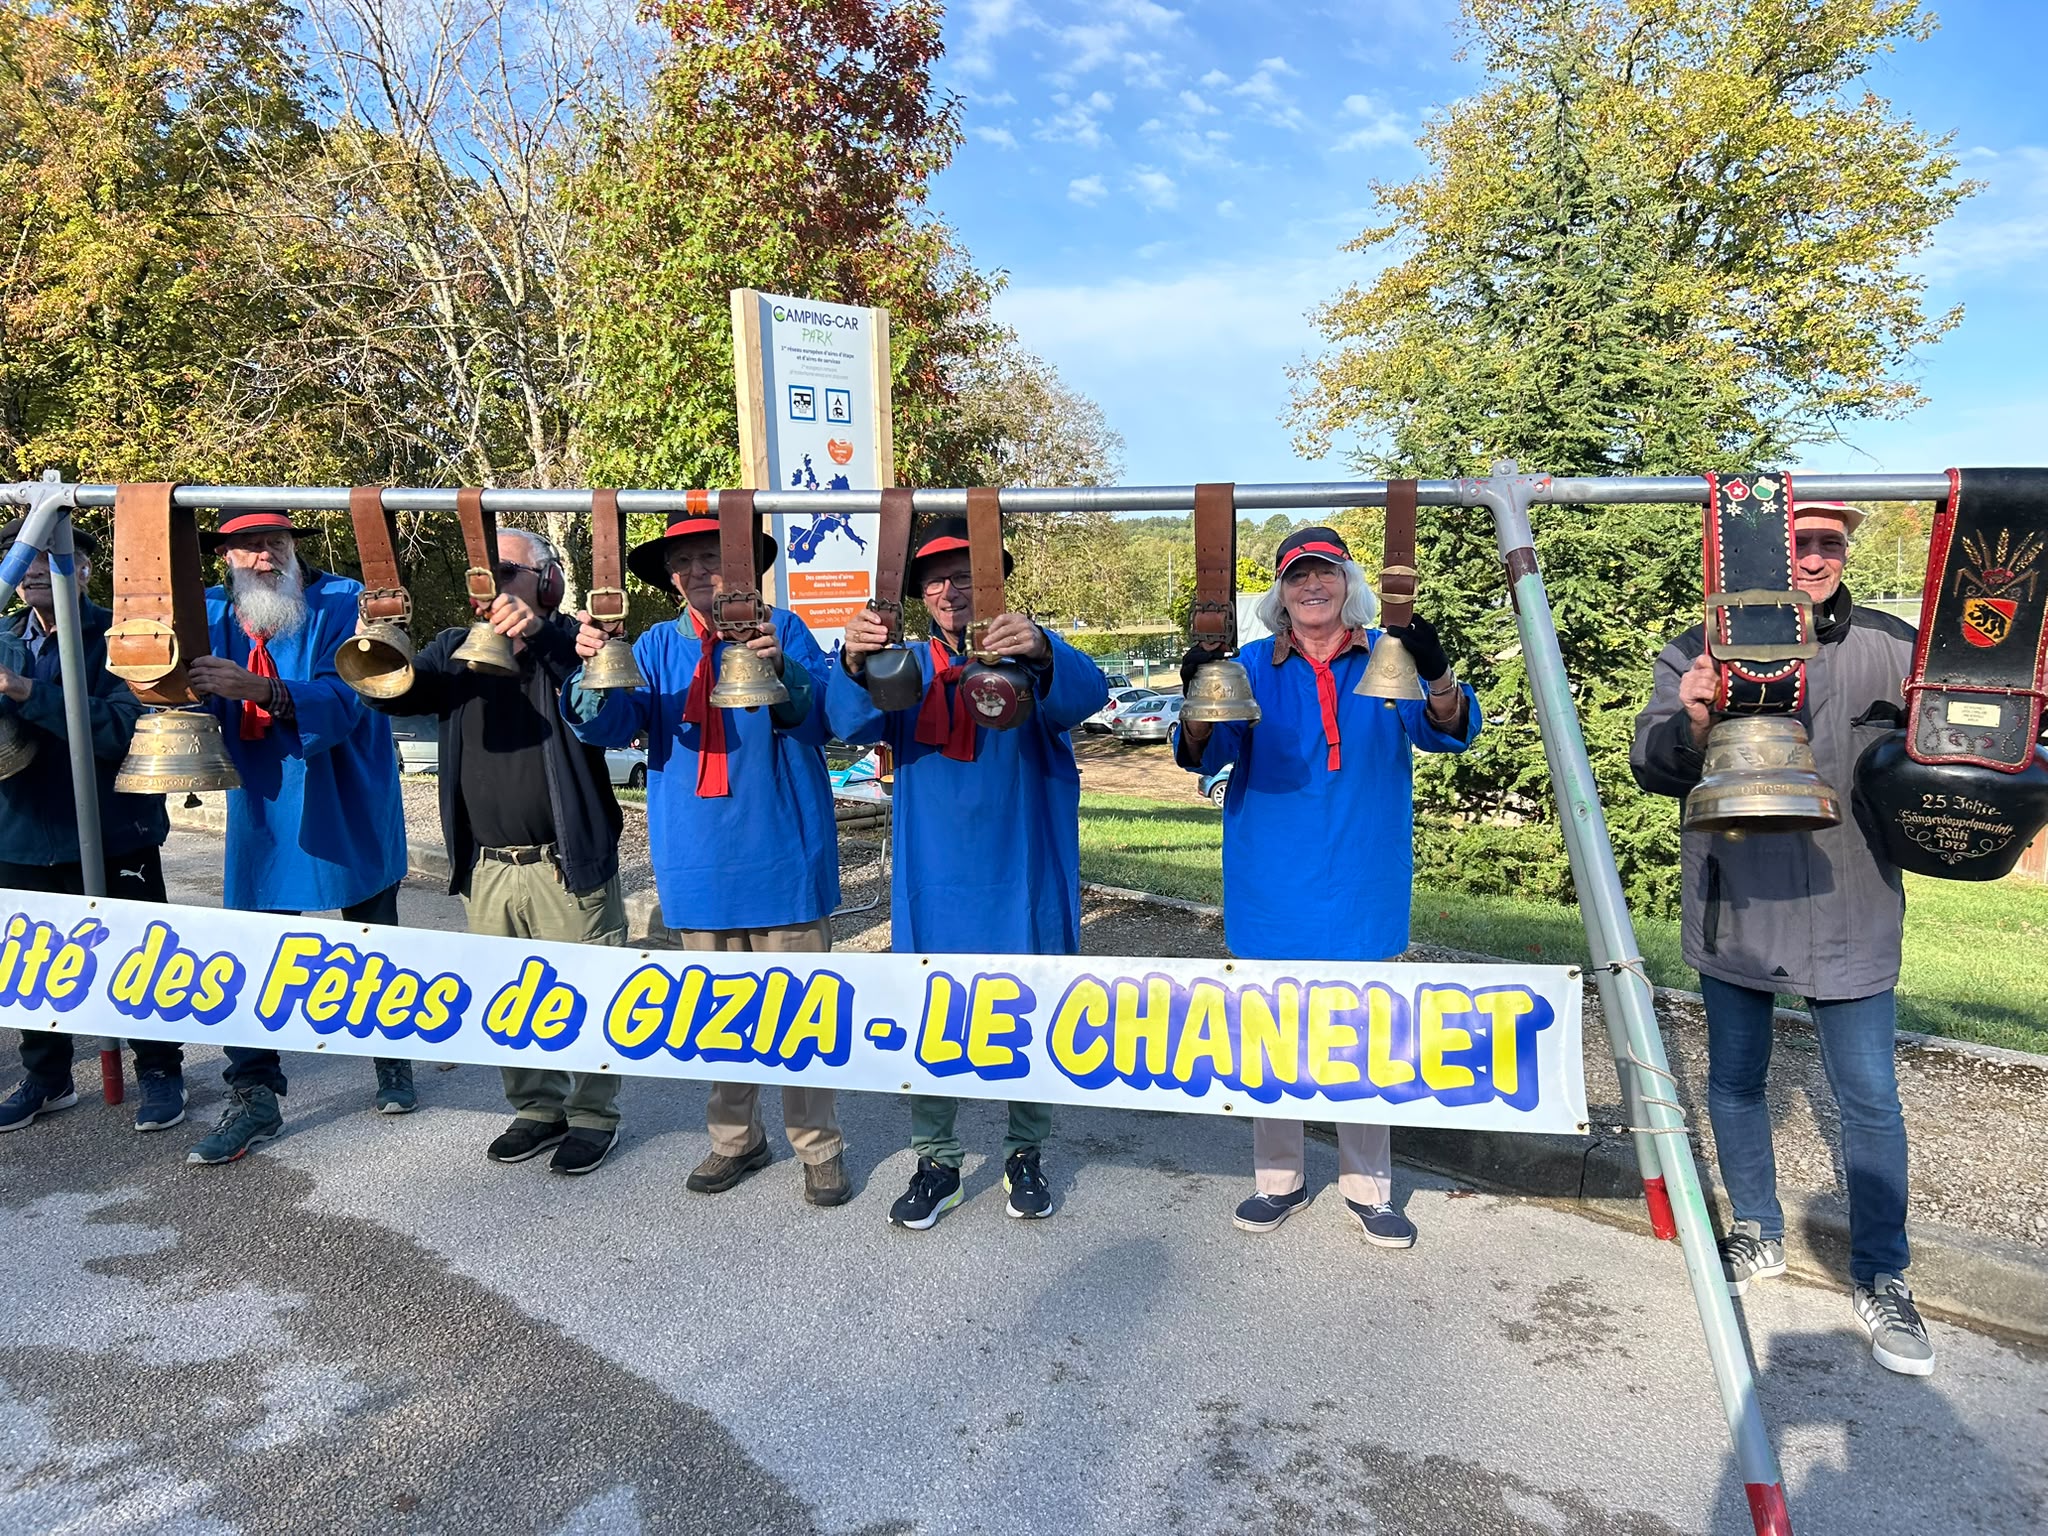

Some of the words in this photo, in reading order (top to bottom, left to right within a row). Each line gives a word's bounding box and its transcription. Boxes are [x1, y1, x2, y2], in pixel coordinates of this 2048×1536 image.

[773, 305, 859, 331] CAMPING-CAR
[802, 328, 833, 346] PARK
[1922, 793, 1947, 809] 25
[1952, 795, 2002, 816] Jahre
[1939, 838, 1968, 850] 1979
[107, 920, 246, 1026] des
[254, 932, 472, 1043] Fêtes
[482, 955, 587, 1051] de
[603, 963, 855, 1072] GIZIA
[914, 970, 1037, 1081] LE
[1046, 972, 1555, 1112] CHANELET
